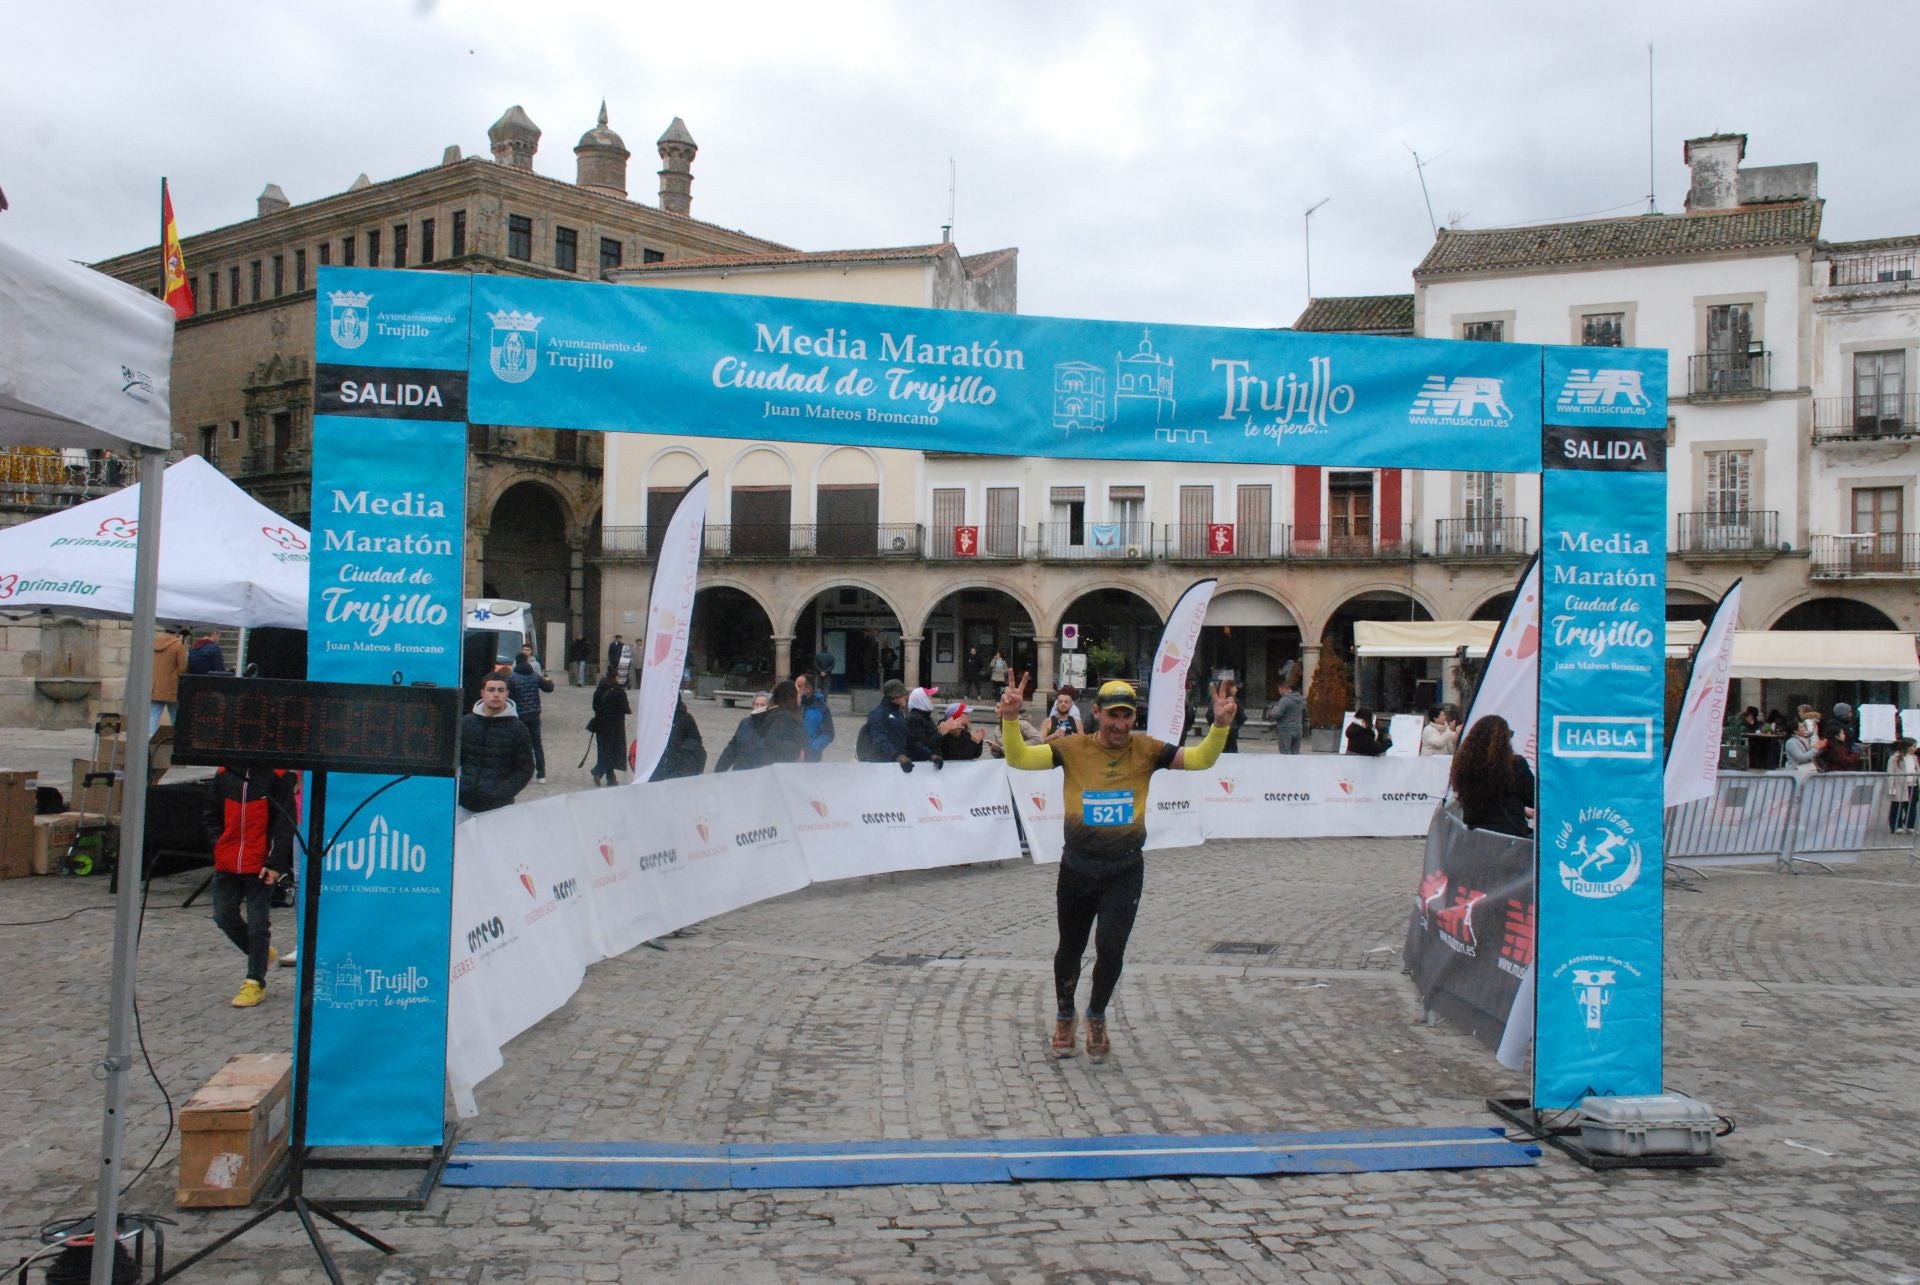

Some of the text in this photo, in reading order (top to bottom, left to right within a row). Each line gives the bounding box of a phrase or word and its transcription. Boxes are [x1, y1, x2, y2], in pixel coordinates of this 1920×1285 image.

[377, 311, 456, 323] Ayuntamiento de
[376, 323, 429, 339] Trujillo
[548, 337, 648, 353] Ayuntamiento de
[754, 323, 1025, 370] Media Maratón
[548, 351, 614, 372] Trujillo
[340, 381, 444, 407] SALIDA
[712, 356, 997, 414] Ciudad de Trujillo
[1212, 356, 1356, 426] Trujillo
[763, 401, 939, 426] Juan Mateos Broncano
[1556, 403, 1647, 416] www.musicrun.es
[1244, 416, 1260, 437] te
[1408, 415, 1510, 429] www.musicrun.es
[1563, 438, 1647, 460] SALIDA
[332, 490, 446, 518] Media
[50, 537, 138, 550] primaflo
[323, 529, 453, 555] Maratón
[1559, 531, 1650, 554] Media
[339, 563, 434, 585] Ciudad de
[1553, 565, 1657, 587] Maratón
[16, 579, 101, 596] primaflor
[322, 587, 448, 637] Trujillo
[1564, 594, 1641, 613] Ciudad de
[326, 640, 445, 654] Juan Mateos Broncano
[1552, 615, 1654, 658] Trujillo
[1555, 661, 1652, 672] Juan Mateos Broncano
[1713, 678, 1726, 696] DE
[1566, 728, 1638, 746] HABLA
[1092, 805, 1124, 823] 521
[1555, 806, 1634, 850] Club Atletismo
[1565, 877, 1624, 894] TRUJILLO
[364, 966, 429, 994] Trujillo
[384, 994, 393, 1006] te
